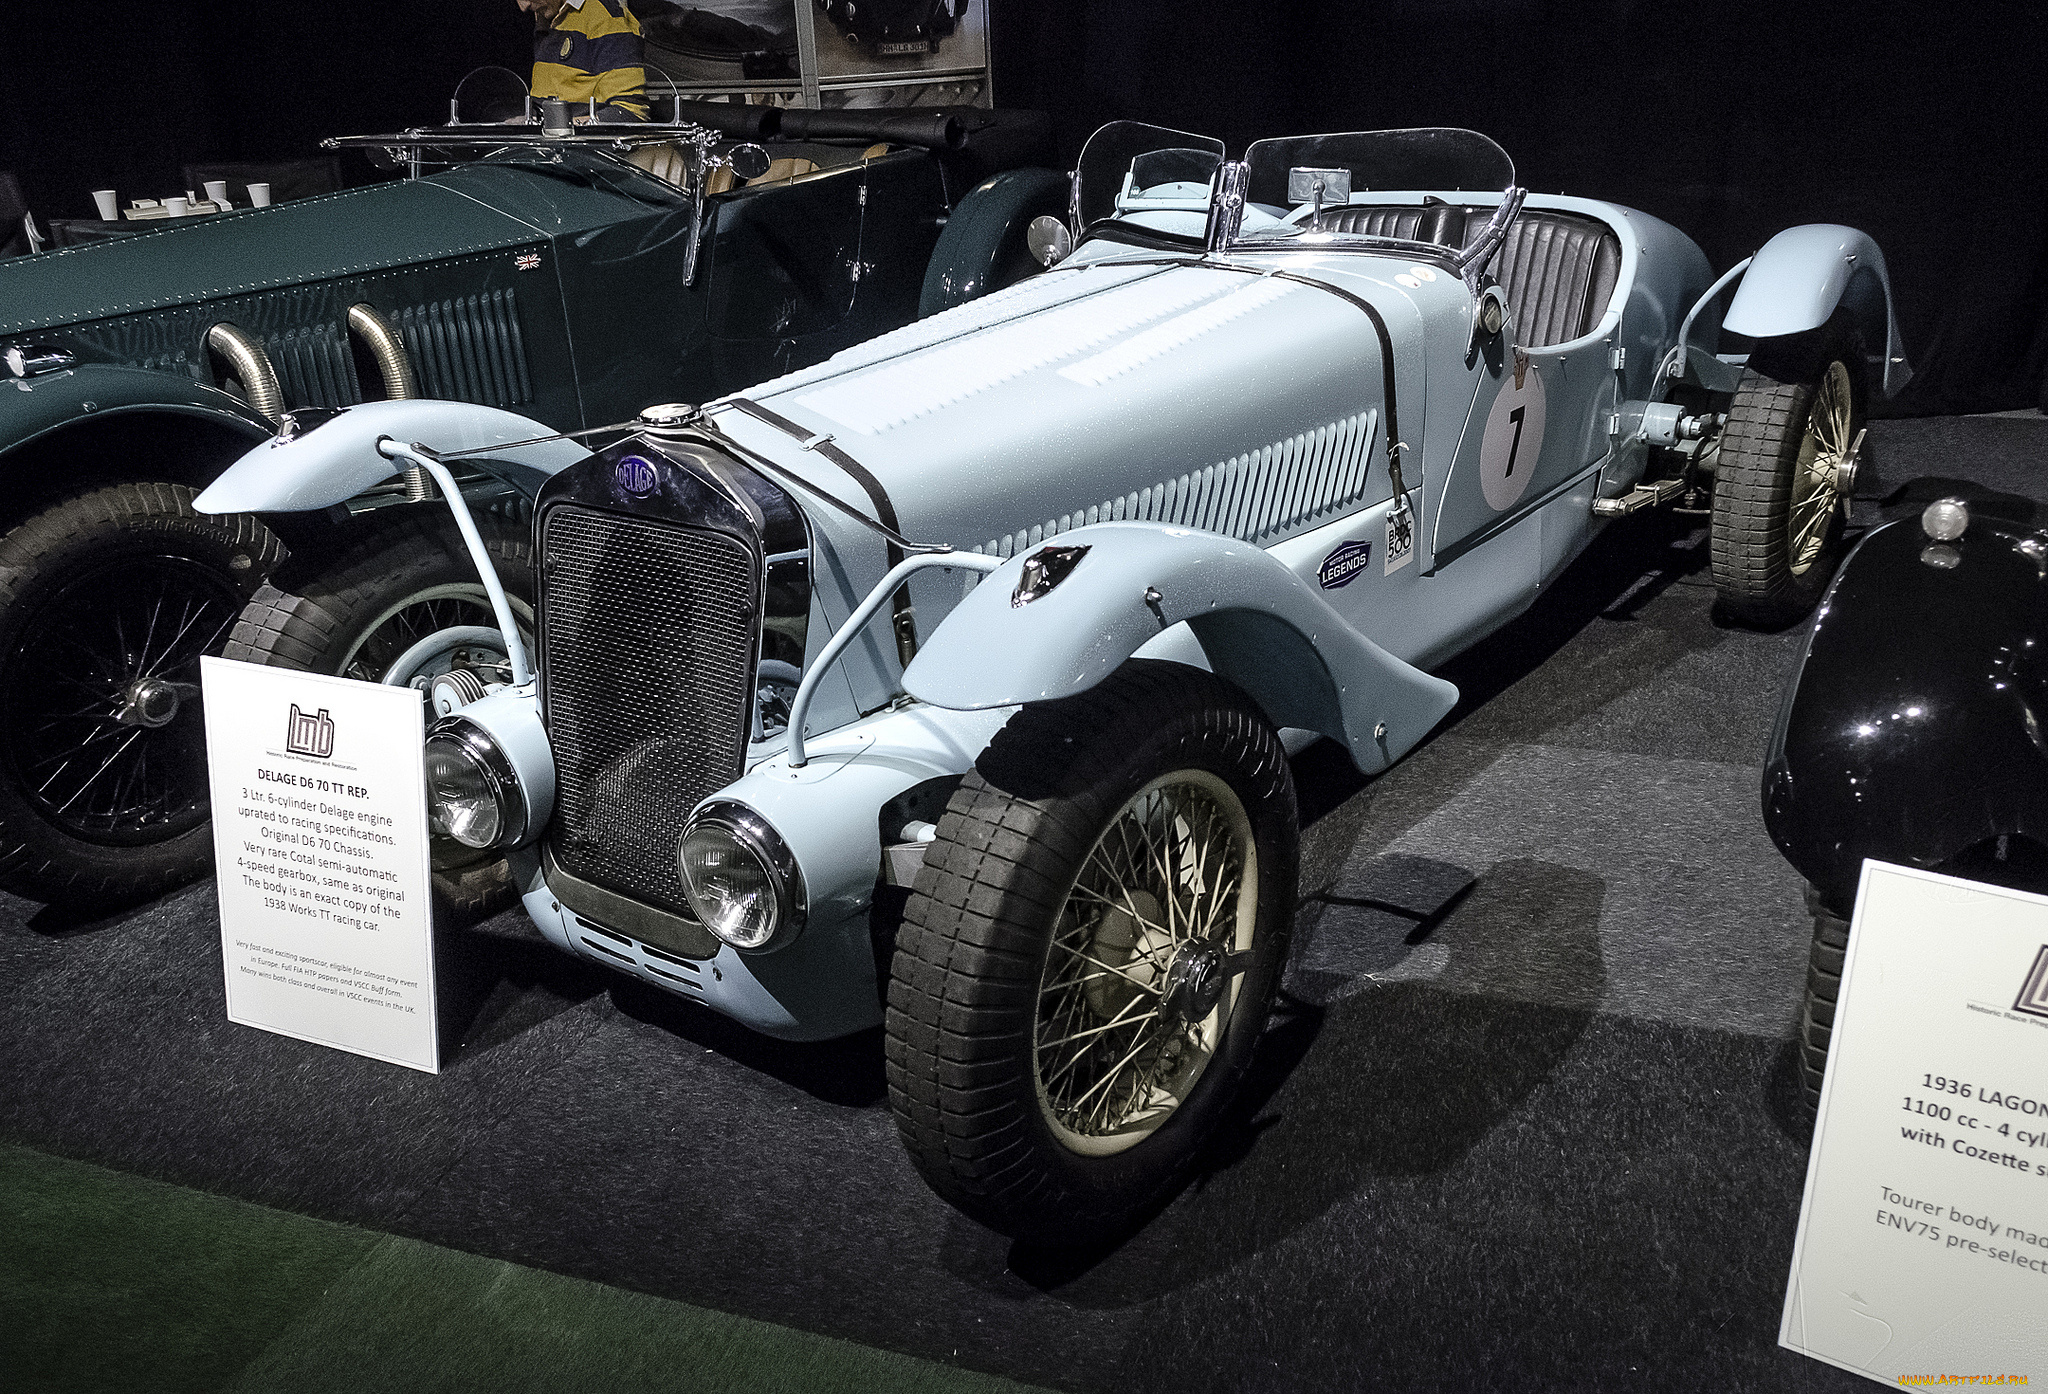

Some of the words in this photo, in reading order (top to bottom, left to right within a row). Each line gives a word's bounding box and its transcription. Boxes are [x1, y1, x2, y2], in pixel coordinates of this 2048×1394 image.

[1505, 405, 1525, 479] 7
[618, 463, 653, 492] DELAGE
[1388, 533, 1411, 558] 500
[1322, 553, 1366, 583] LEGENDS
[258, 769, 297, 786] DELAGE
[300, 776, 314, 788] D6
[316, 780, 329, 791] 70
[332, 782, 344, 794] TT
[348, 786, 369, 799] REP.
[238, 807, 275, 821] uprated
[278, 814, 288, 824] to
[292, 818, 321, 833] racing
[324, 824, 396, 845] specifications.
[242, 788, 248, 798] 3
[251, 790, 265, 802] Ltr.
[268, 793, 317, 812] 6-cylinder
[320, 803, 354, 821] Delage
[358, 812, 392, 826] engine
[243, 841, 265, 857] Very
[268, 848, 287, 860] rare
[290, 851, 315, 865] Cotal
[318, 859, 397, 882] semi-automatic
[261, 827, 299, 844] Original
[302, 835, 315, 847] D6
[318, 838, 330, 850] 70
[334, 842, 373, 859] Chassis.
[238, 857, 275, 874] 4-speed
[278, 868, 320, 886] gearbox,
[323, 878, 349, 890] same
[352, 884, 363, 893] as
[366, 886, 404, 901] original
[242, 874, 260, 888] The
[263, 879, 287, 896] body
[290, 885, 297, 896] is
[300, 890, 311, 899] an
[315, 893, 341, 906] exact
[344, 900, 367, 914] copy
[370, 903, 380, 914] of
[384, 906, 400, 919] the
[264, 897, 286, 910] 1938
[288, 902, 317, 917] Works
[319, 909, 330, 920] TT
[333, 915, 361, 930] racing
[364, 921, 380, 931] car.
[236, 940, 248, 949] Very
[250, 943, 261, 951] fast
[275, 951, 298, 962] exciting
[330, 963, 352, 973] eligible
[353, 967, 362, 975] for
[364, 971, 385, 980] almost
[387, 977, 398, 985] any
[400, 980, 417, 988] event
[282, 963, 292, 971] Full
[293, 966, 303, 974] FIA
[318, 974, 339, 982] papers
[354, 981, 369, 990] VSCC
[371, 985, 384, 994] Buff
[240, 966, 257, 976] Many
[273, 974, 286, 982] both
[288, 978, 302, 986] class
[316, 986, 338, 995] overall
[347, 992, 362, 1001] VSCC
[364, 997, 383, 1006] events
[393, 1003, 403, 1011] the
[1966, 1003, 2002, 1017] Historic
[2004, 1012, 2027, 1023] Race
[1922, 1074, 1972, 1098] 1936
[1902, 1097, 1951, 1121] 1100
[1957, 1115, 1978, 1129] cc
[1998, 1123, 2010, 1137] 4
[1901, 1127, 1945, 1148] with
[1952, 1140, 2029, 1172] Cozette
[1877, 1210, 1940, 1240] ENV75
[1881, 1186, 1944, 1216] Tourer
[1950, 1206, 2000, 1236] body
